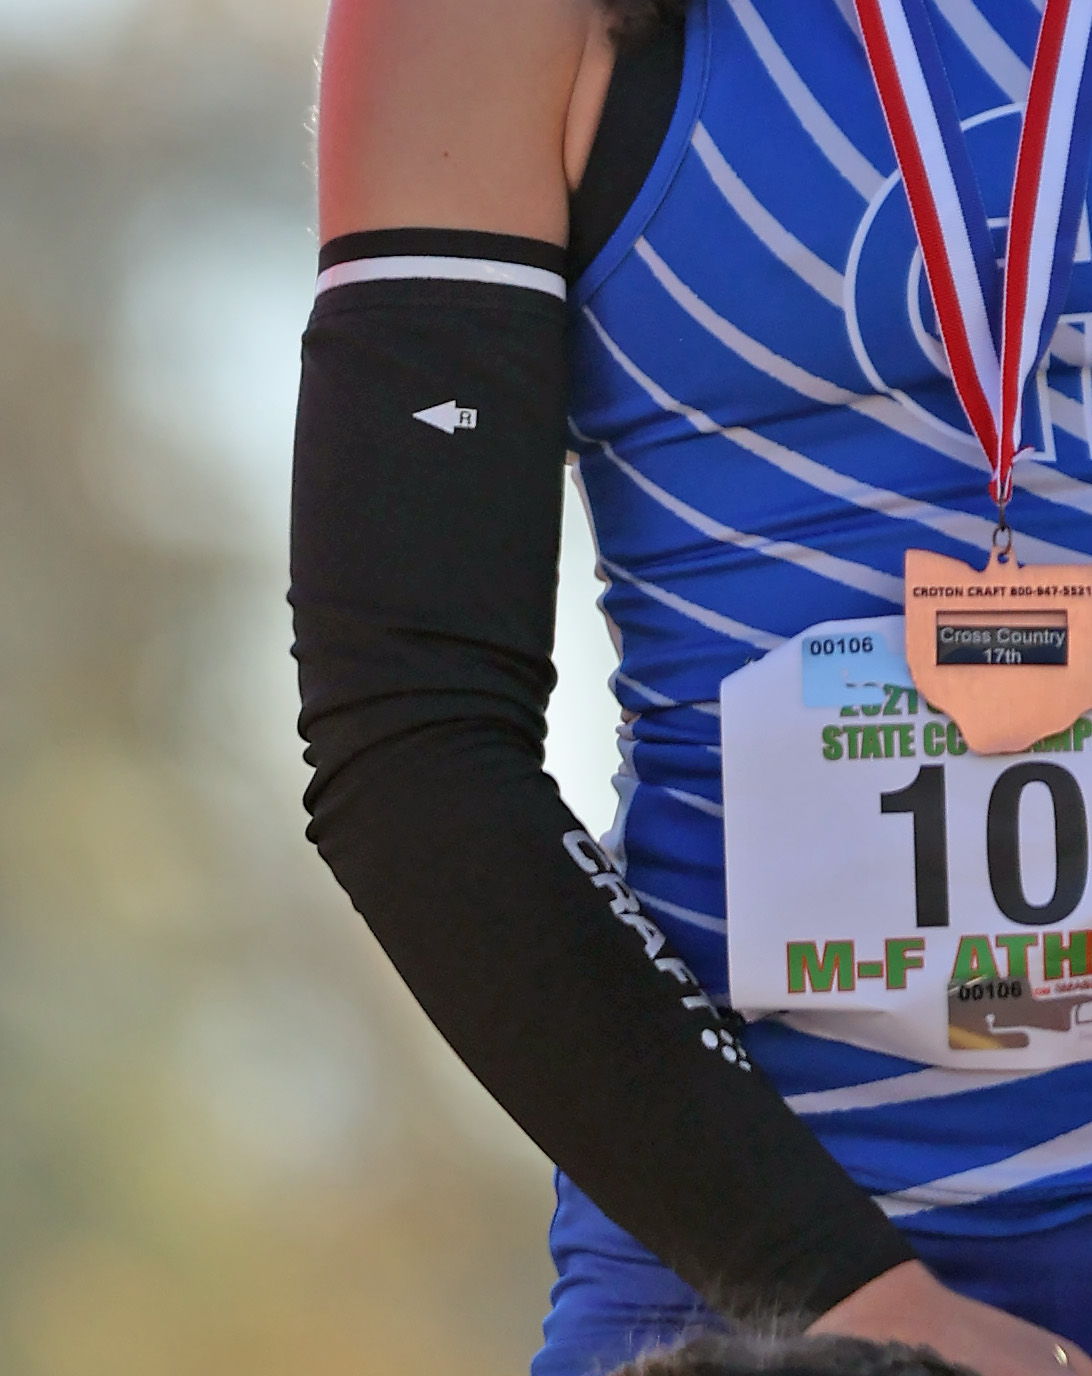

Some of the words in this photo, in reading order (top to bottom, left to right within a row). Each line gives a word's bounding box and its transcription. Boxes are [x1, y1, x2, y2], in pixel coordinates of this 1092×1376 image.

[912, 586, 964, 597] CROTON
[967, 586, 1006, 597] CRAFT
[810, 636, 874, 656] 00106
[940, 627, 991, 644] Cross
[997, 628, 1065, 648] Country
[984, 648, 1022, 664] 17th
[822, 723, 916, 761] STATE
[786, 937, 926, 994] M-F
